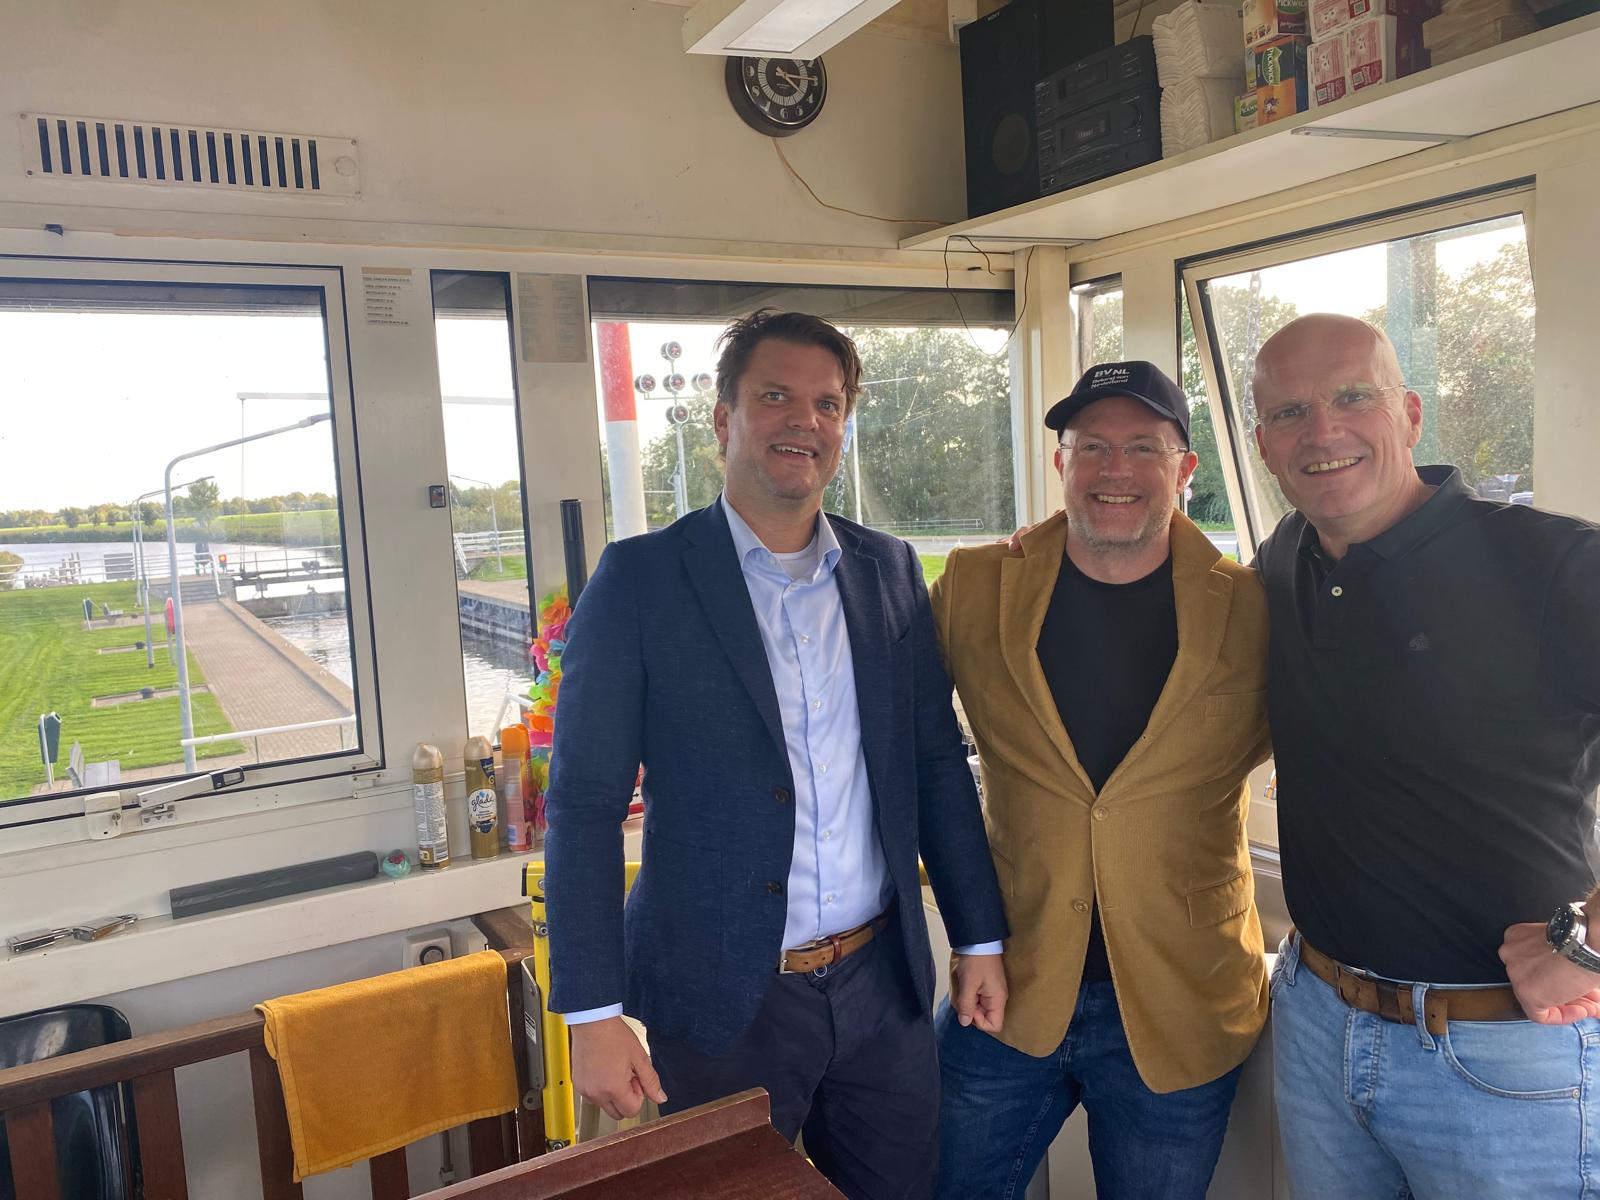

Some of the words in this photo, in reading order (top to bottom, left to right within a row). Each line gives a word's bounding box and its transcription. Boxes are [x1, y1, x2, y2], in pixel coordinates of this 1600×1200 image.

[1266, 47, 1275, 86] PICKWICK
[780, 107, 789, 119] 6
[1095, 368, 1130, 378] BVNL
[471, 793, 495, 812] glade
